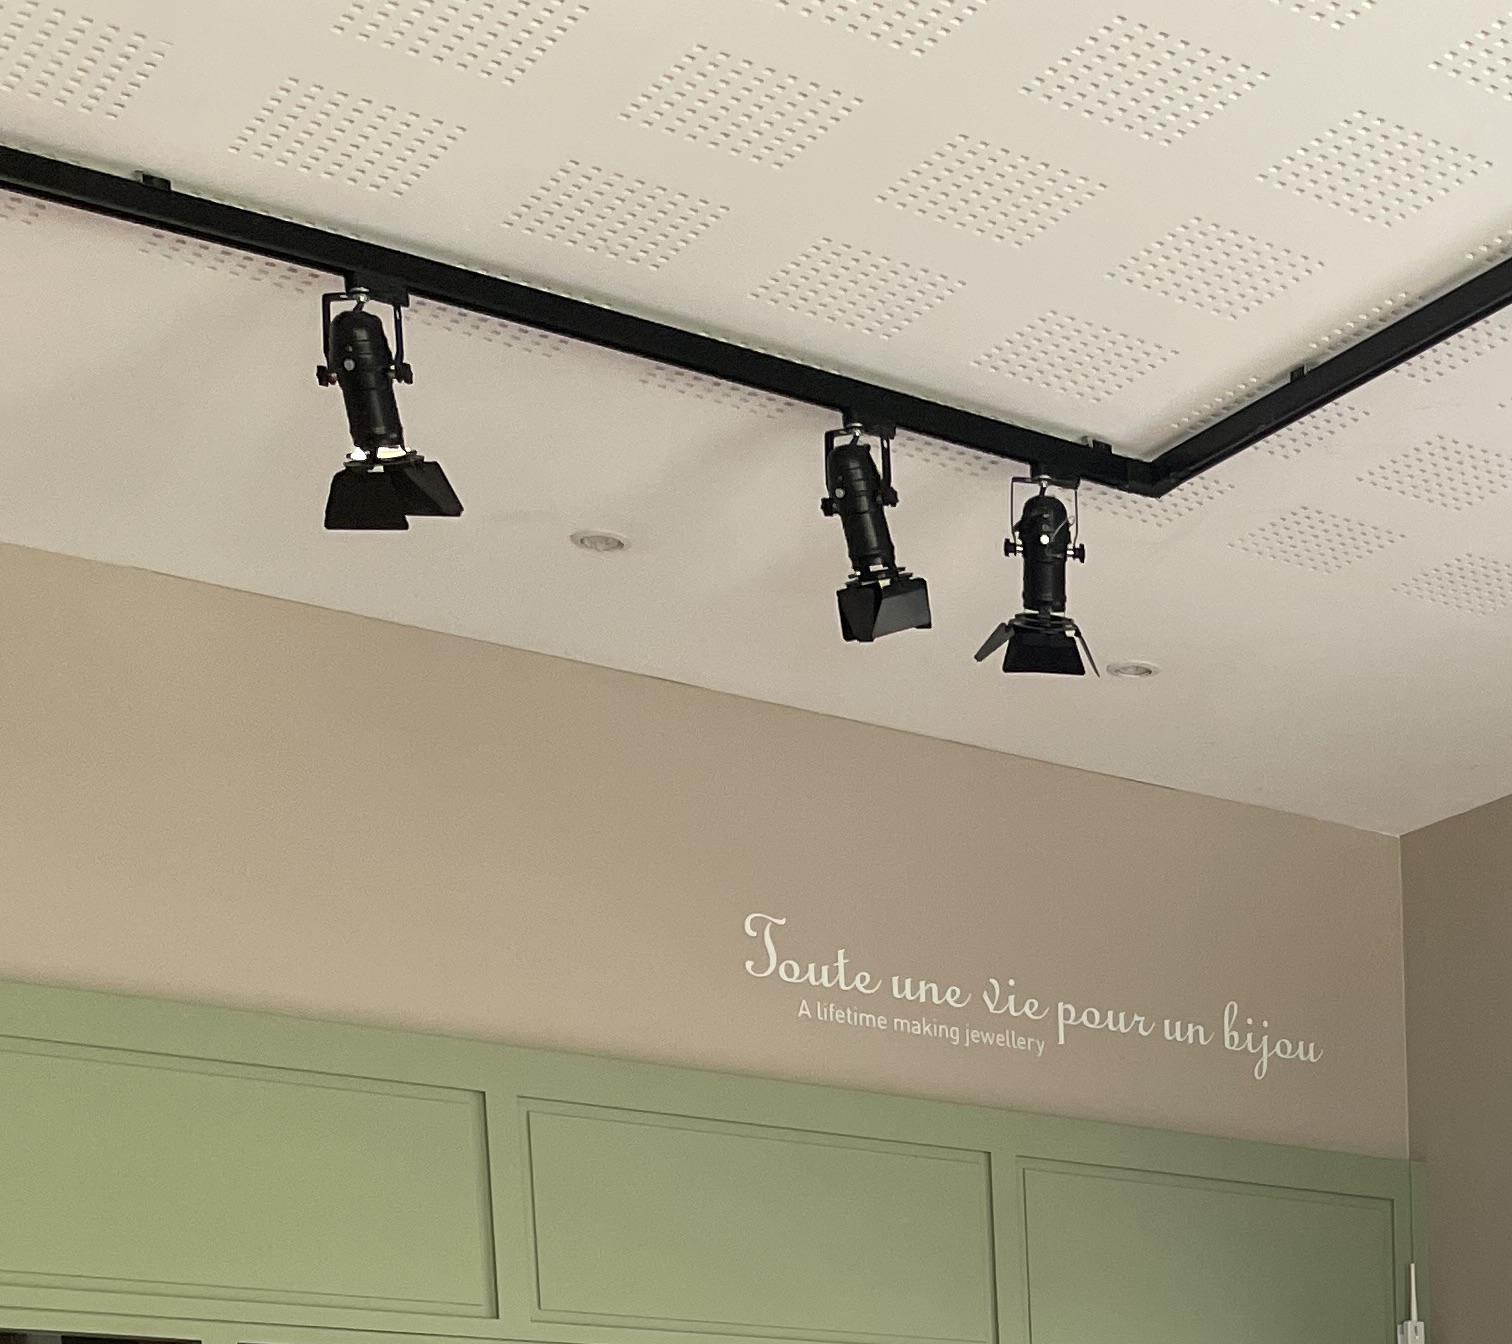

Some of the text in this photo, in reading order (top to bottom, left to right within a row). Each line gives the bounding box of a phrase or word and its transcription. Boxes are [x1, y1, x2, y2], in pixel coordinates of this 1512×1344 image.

[744, 912, 882, 994] Toute
[891, 976, 971, 1010] une
[1056, 1001, 1155, 1044] pour
[1163, 1018, 1214, 1045] un
[1223, 1001, 1323, 1080] bijou
[798, 1000, 1046, 1056] A lifetime making jewellery
